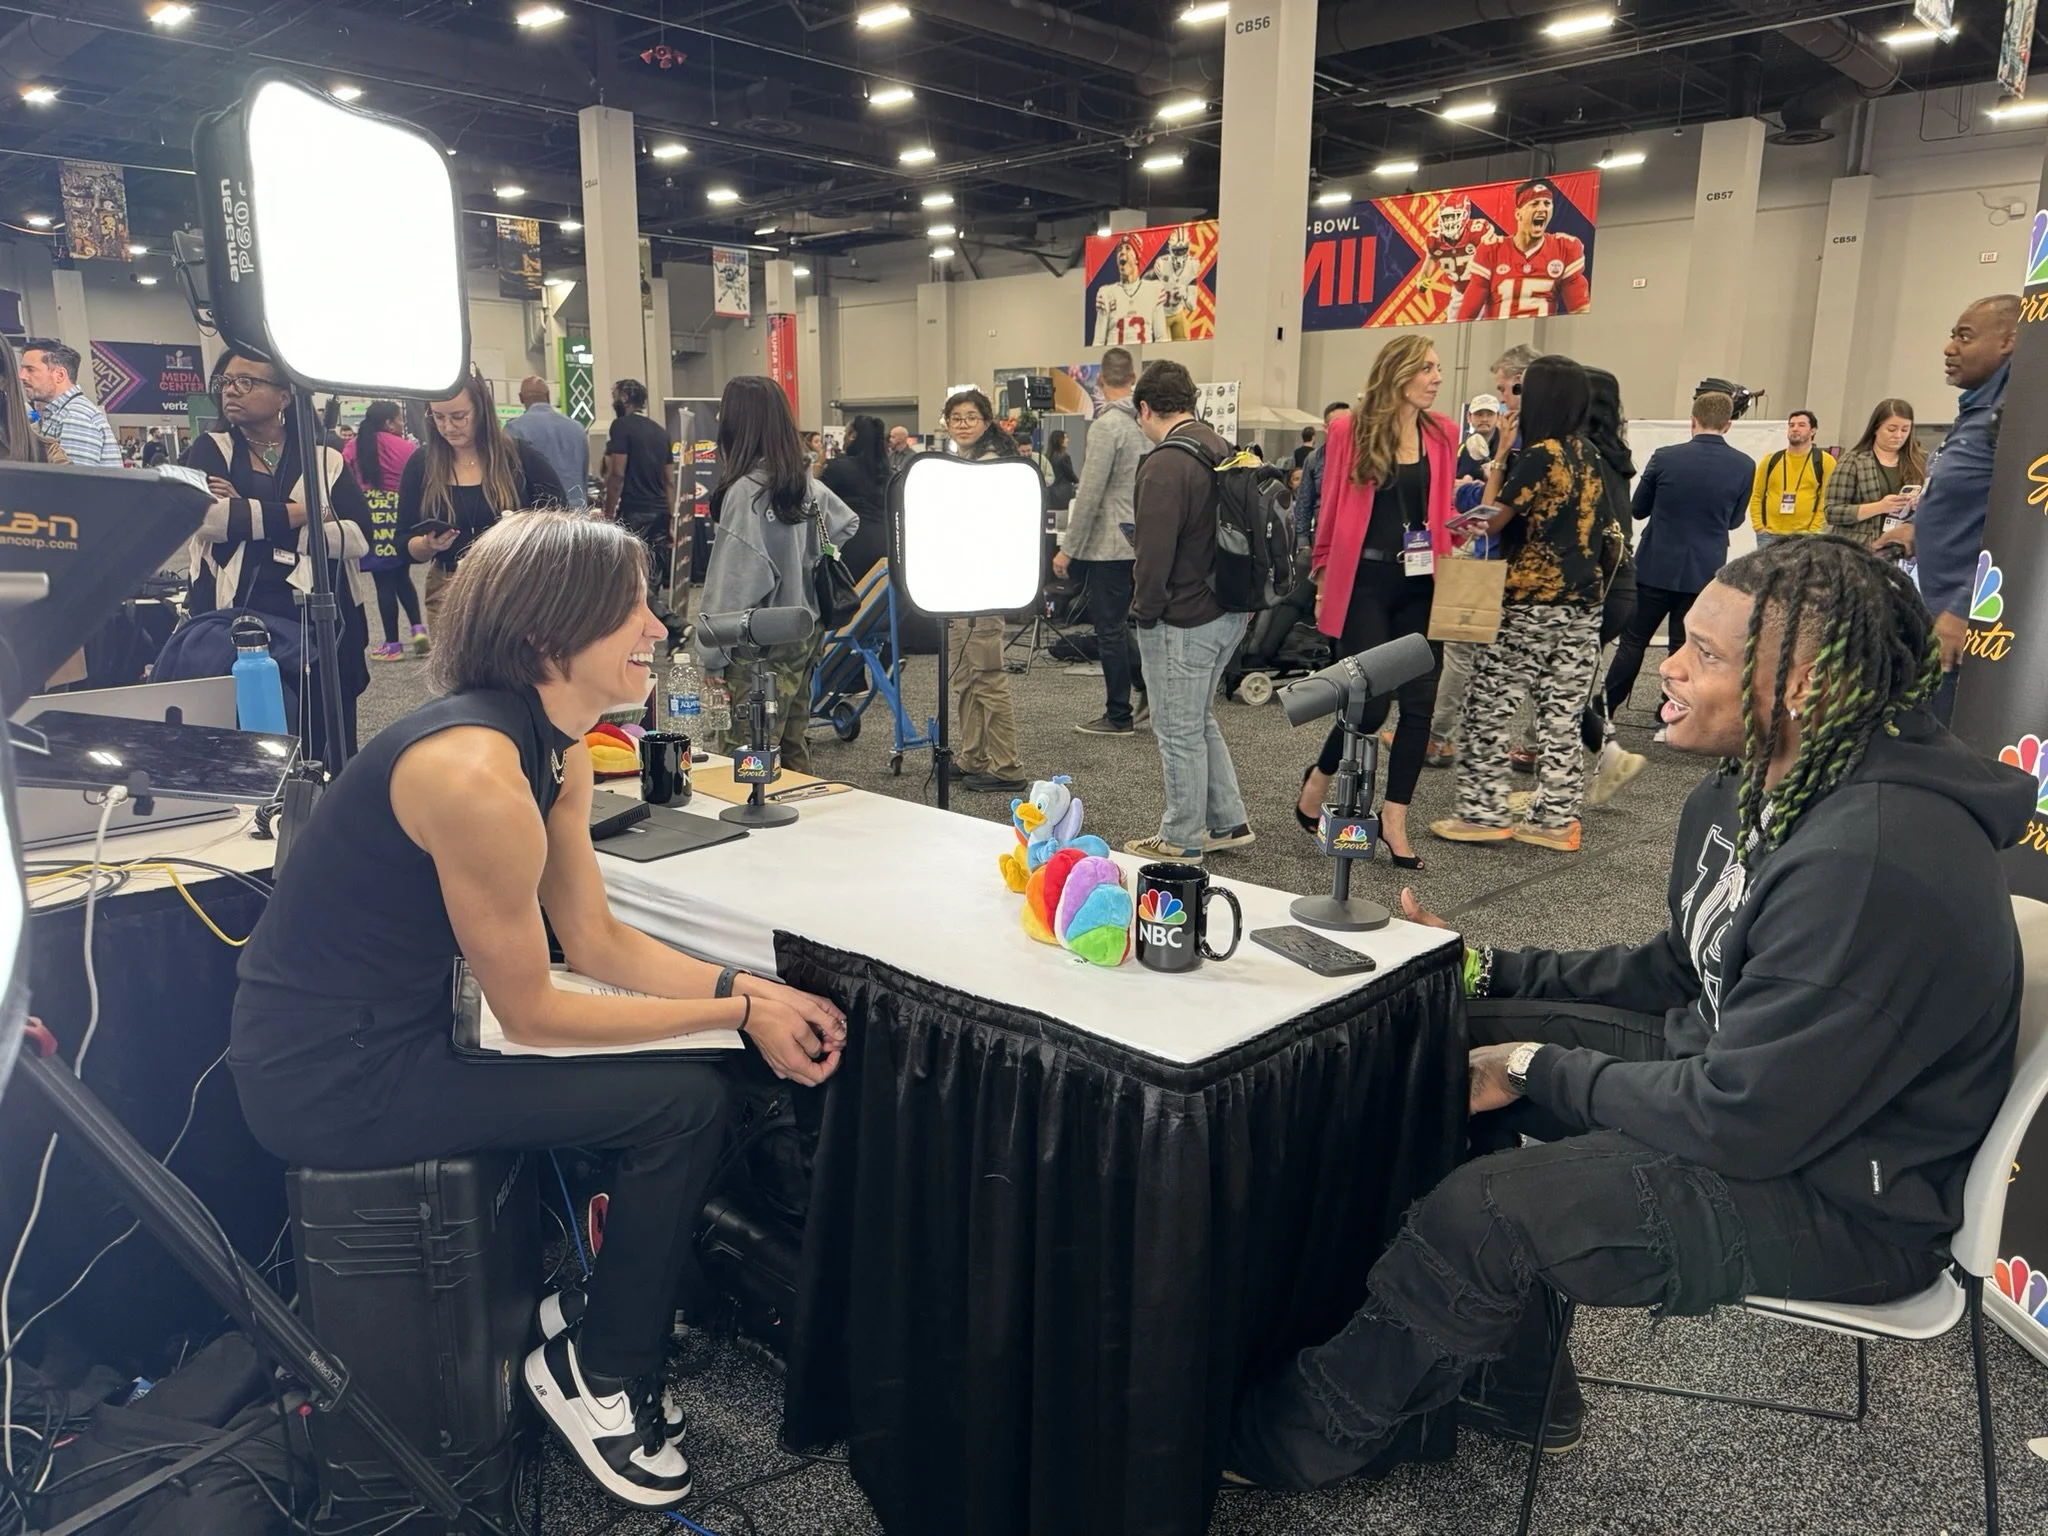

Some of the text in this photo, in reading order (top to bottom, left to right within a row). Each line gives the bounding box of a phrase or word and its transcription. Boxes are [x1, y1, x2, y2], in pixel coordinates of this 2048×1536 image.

[1235, 16, 1271, 35] CB56
[1706, 190, 1734, 202] CB57
[221, 178, 240, 283] amaran
[1313, 216, 1361, 234] BOWL
[1832, 235, 1857, 245] CB58
[1497, 277, 1555, 319] 15
[1117, 316, 1146, 345] 13
[161, 372, 200, 382] MEDIA
[159, 382, 205, 392] CENTER
[161, 400, 188, 411] veriz
[0, 536, 78, 550] ancorp.com
[1963, 622, 2016, 662] orts
[1333, 838, 1372, 852] Sports
[1139, 921, 1183, 949] NBC
[534, 1385, 548, 1398] AIR
